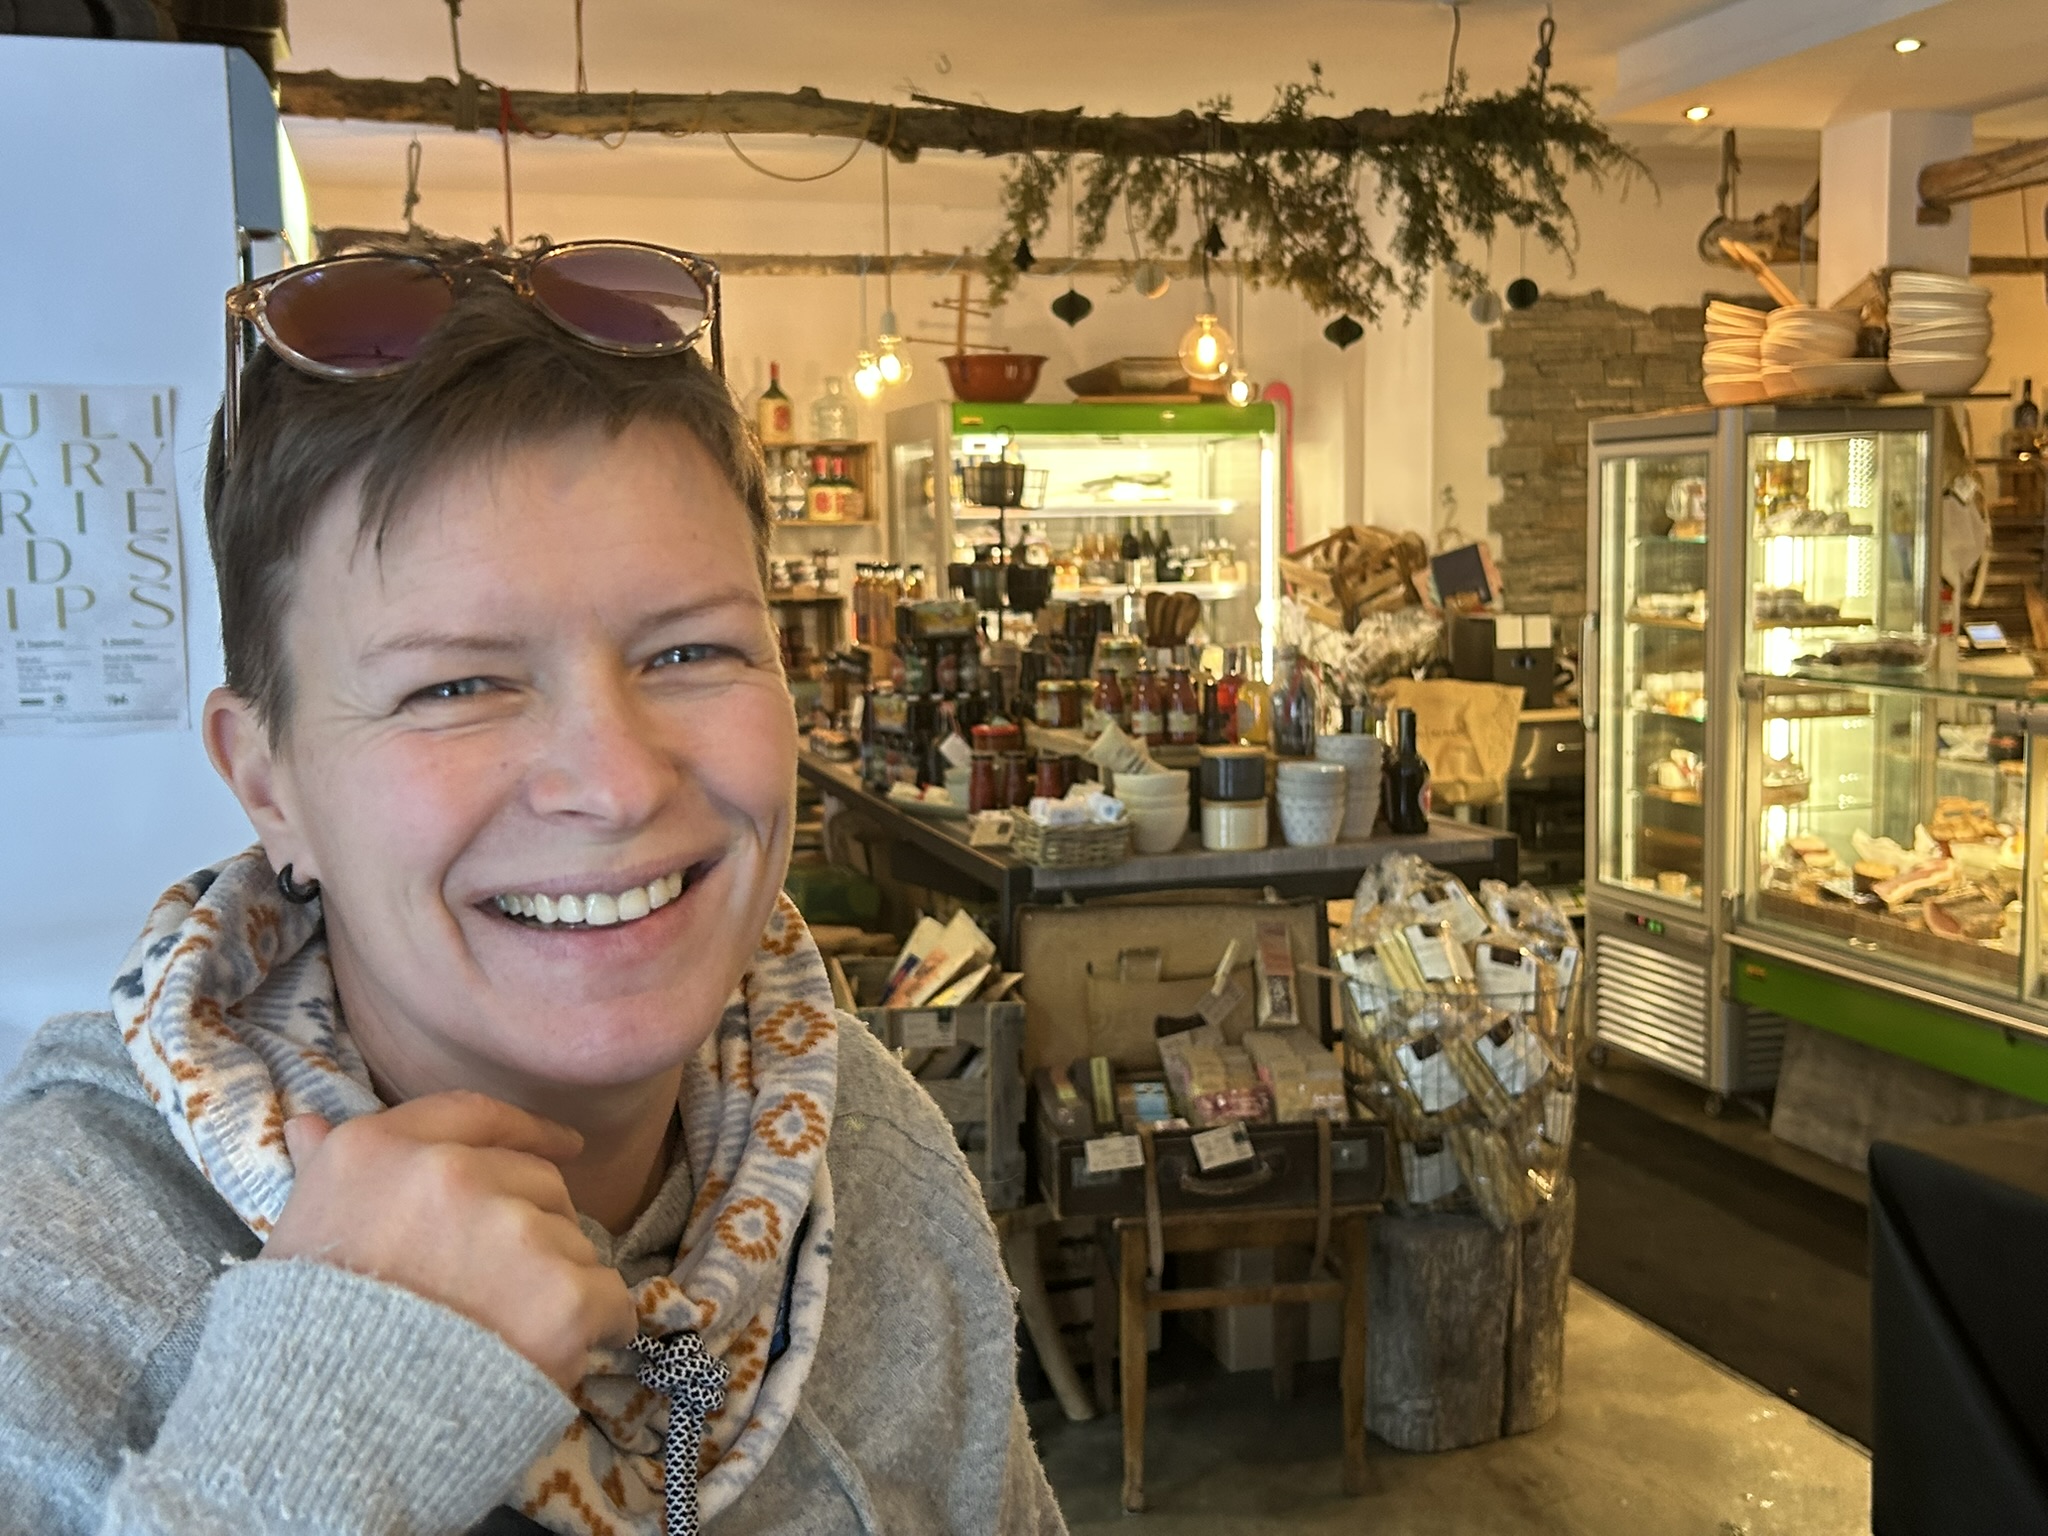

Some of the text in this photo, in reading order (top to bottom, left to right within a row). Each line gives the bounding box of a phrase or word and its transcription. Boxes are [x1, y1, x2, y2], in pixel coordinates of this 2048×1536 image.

[0, 393, 164, 440] ULI
[0, 440, 165, 487] ARY
[0, 489, 170, 535] RIE
[6, 583, 175, 631] IPS
